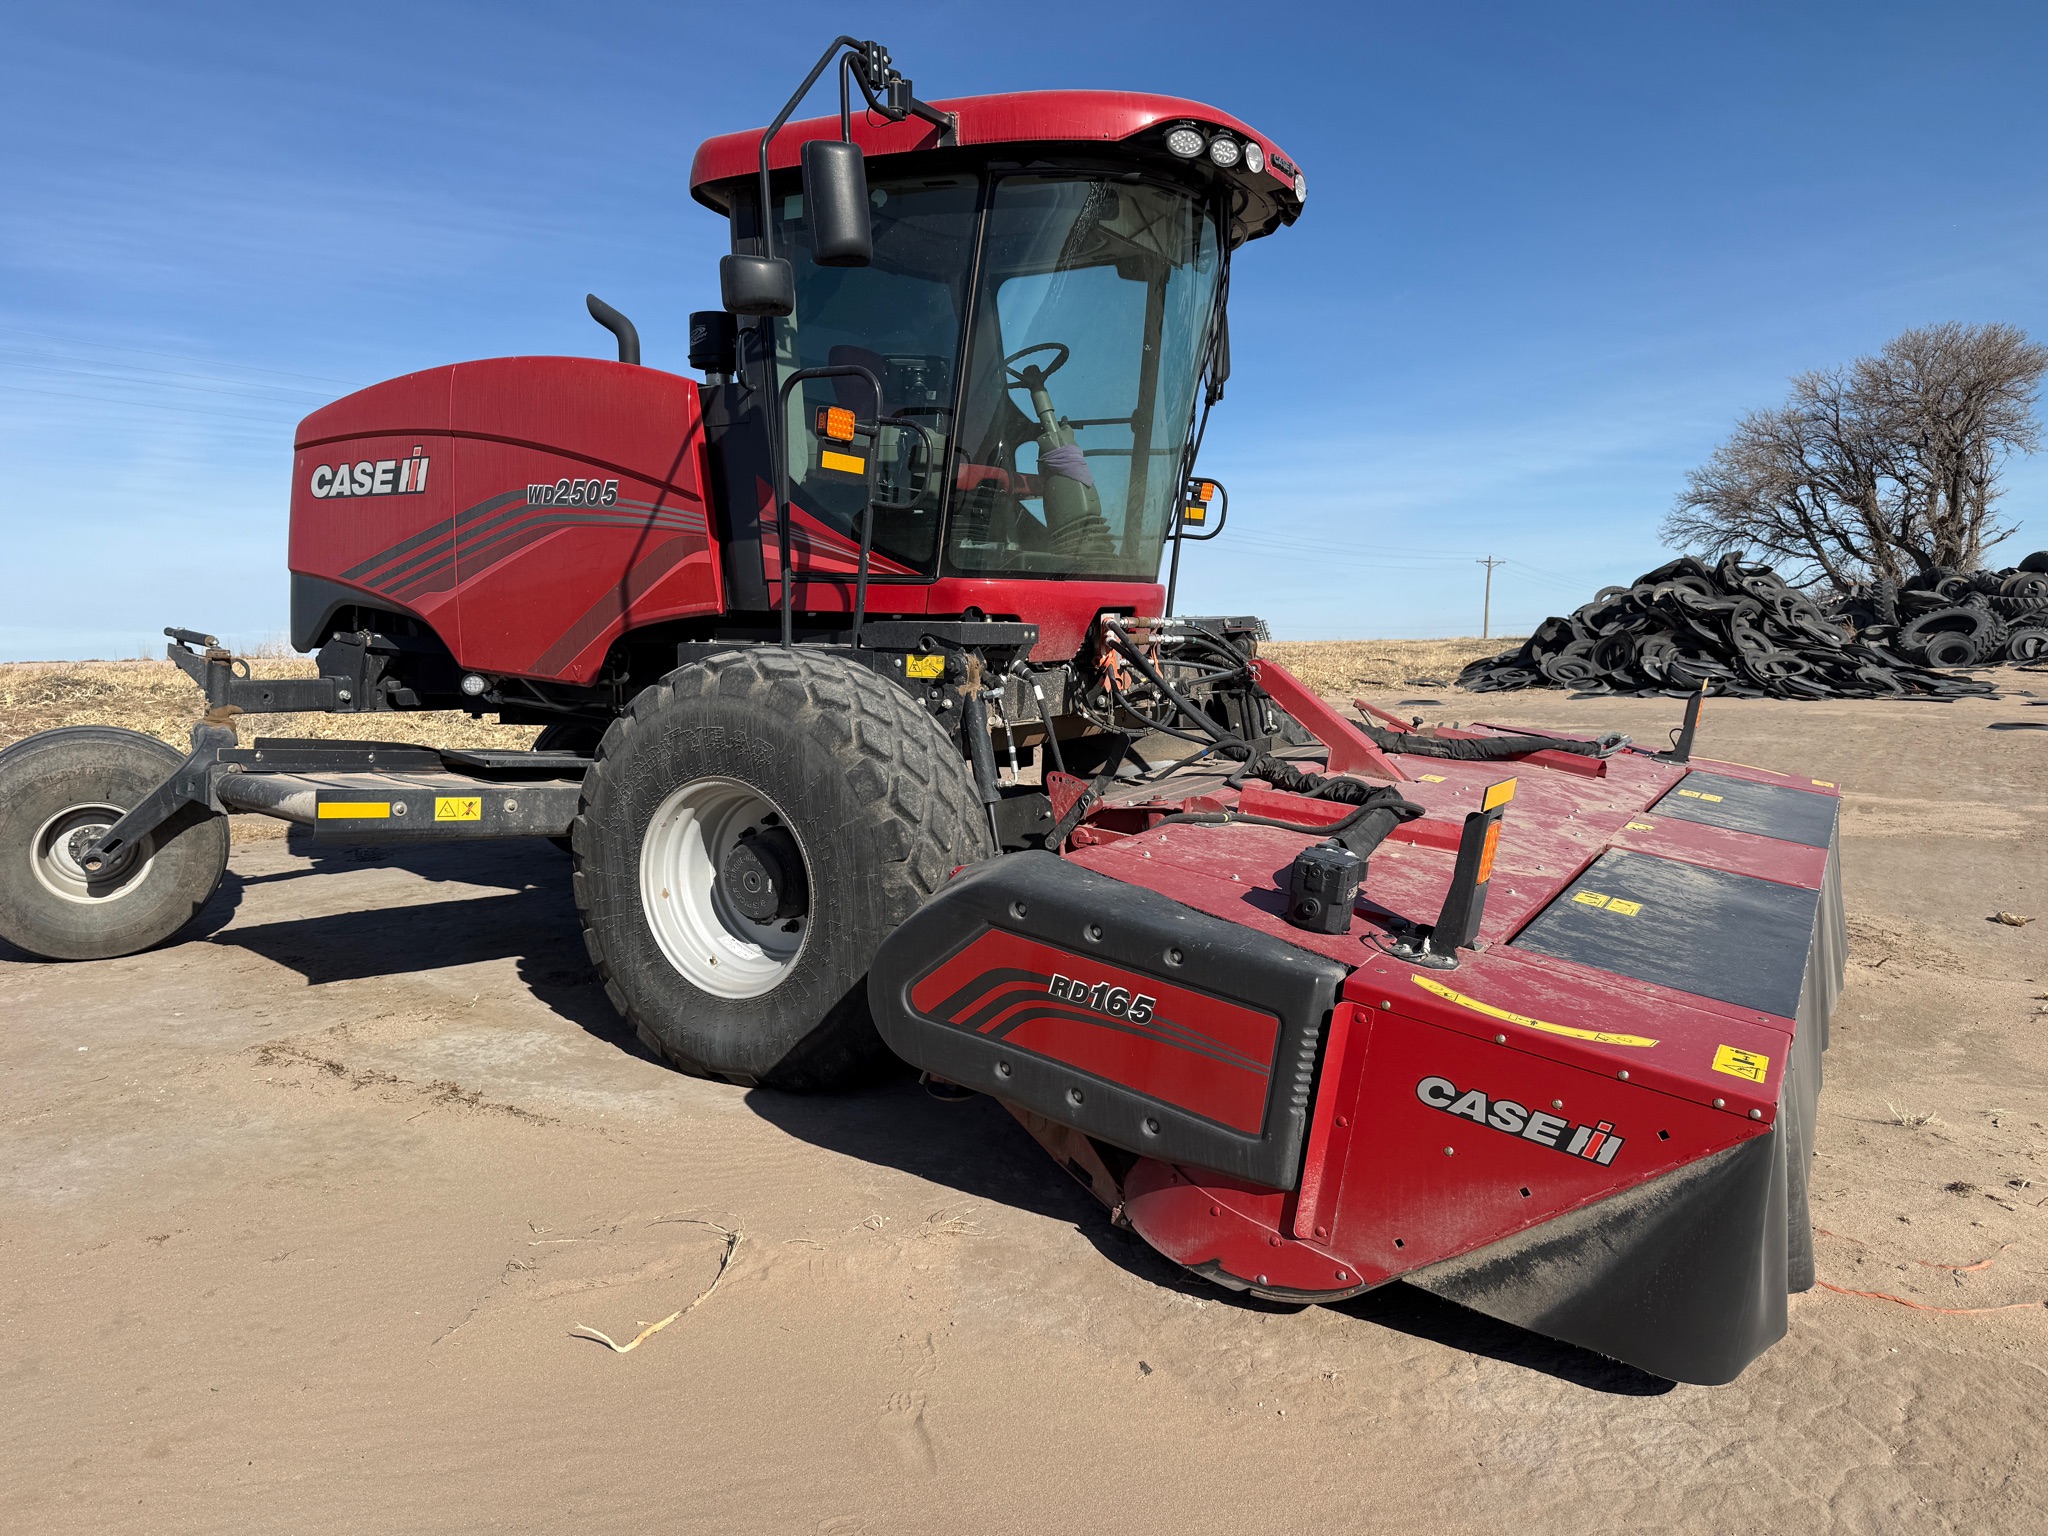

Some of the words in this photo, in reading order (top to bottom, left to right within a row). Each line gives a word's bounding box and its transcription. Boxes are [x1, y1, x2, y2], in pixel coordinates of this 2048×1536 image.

[311, 459, 397, 499] CASE
[398, 445, 431, 495] IH
[527, 478, 619, 507] WD2505
[1048, 973, 1156, 1025] RD165
[1416, 1076, 1568, 1148] CASE
[1566, 1119, 1625, 1167] IH
